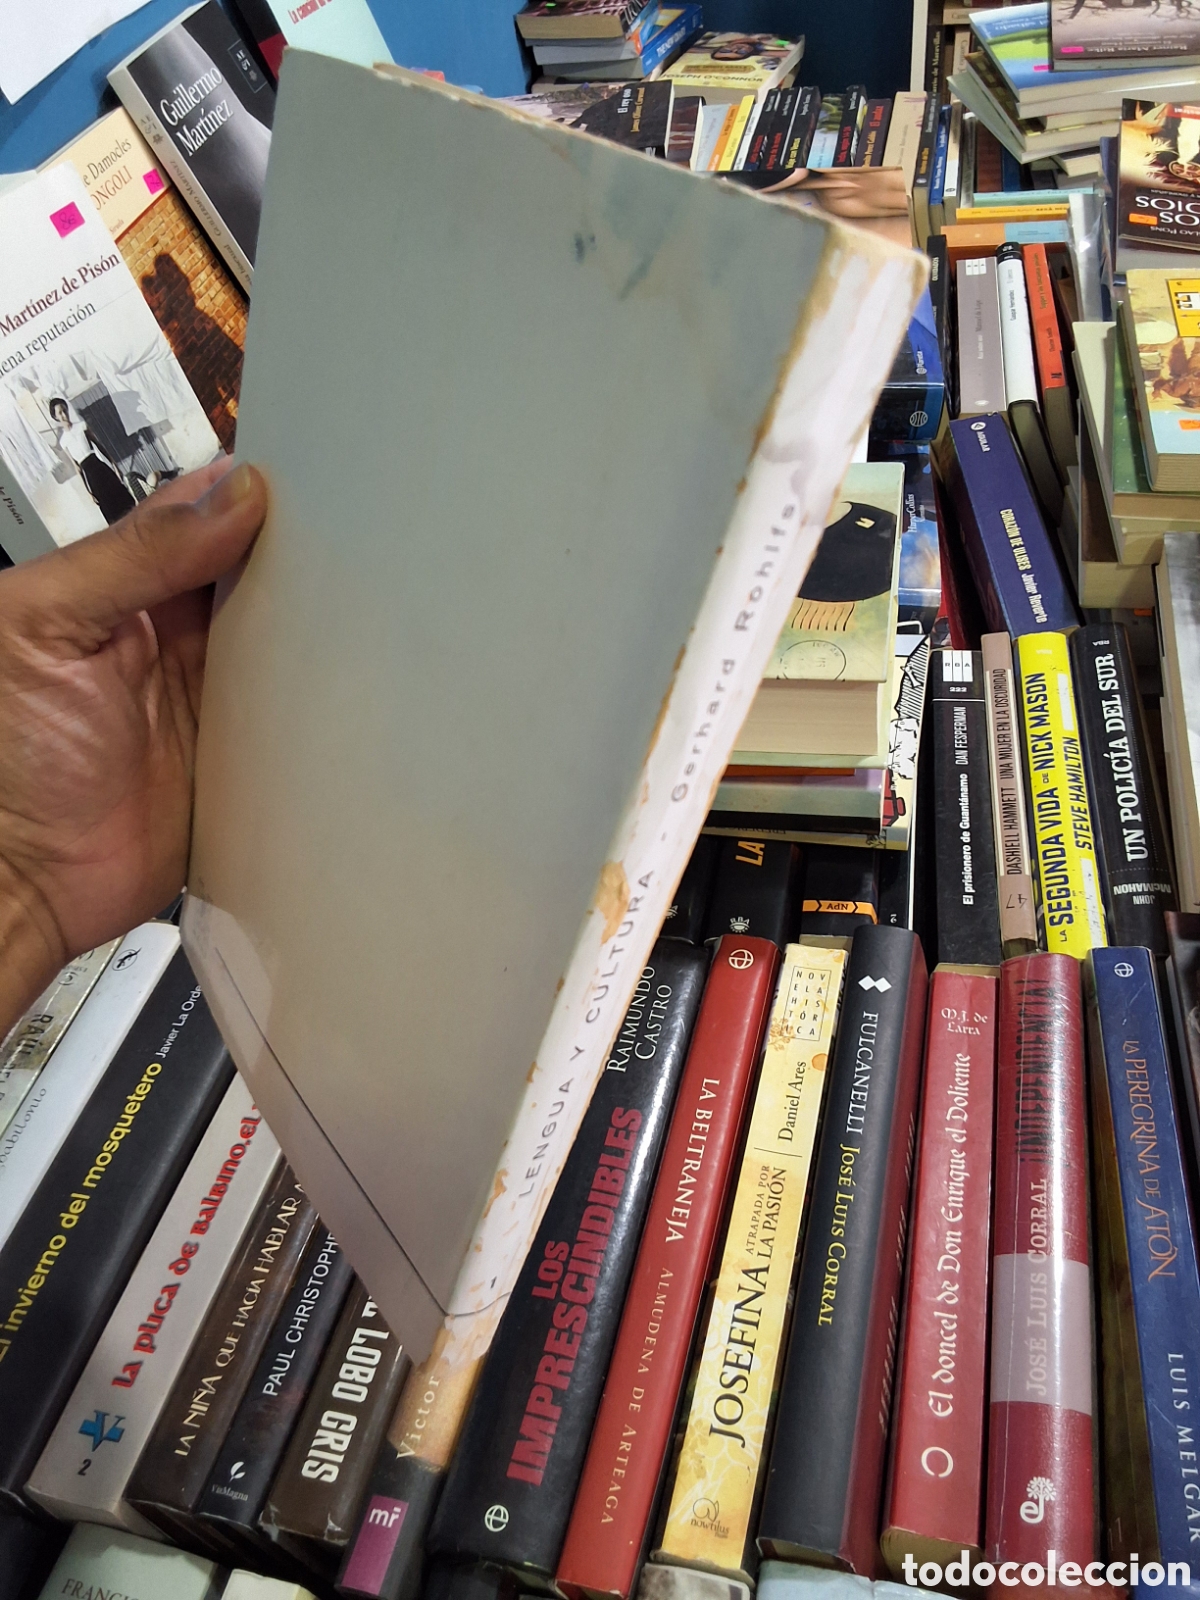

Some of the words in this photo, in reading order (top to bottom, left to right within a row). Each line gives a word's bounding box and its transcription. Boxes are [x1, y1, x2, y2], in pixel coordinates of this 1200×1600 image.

[160, 67, 223, 126] Guillermo
[176, 100, 234, 156] Martínez
[88, 138, 132, 179] Damocles
[0, 284, 63, 338] Martínez
[61, 275, 81, 296] de
[76, 252, 122, 278] Pisón
[25, 300, 97, 357] reputación
[976, 431, 990, 452] AGUILAR
[4, 497, 25, 526] Pisón
[907, 493, 915, 533] HarperCollins
[1000, 508, 1019, 536] CORAZÓN
[1010, 536, 1022, 546] DE
[1012, 546, 1032, 571] ULISES
[1022, 573, 1036, 594] Javier
[1028, 594, 1048, 624] Reverte
[995, 668, 1010, 708] OSCURIDAD
[1095, 652, 1119, 692] SUR
[998, 710, 1010, 721] LA
[1025, 672, 1046, 728] MASON
[1101, 694, 1127, 738] DEL
[954, 706, 968, 749] FESPERMAN
[998, 722, 1011, 734] EN
[1000, 734, 1012, 763] MUJER
[955, 750, 968, 766] DAN
[1000, 764, 1013, 780] UNA
[1032, 730, 1055, 772] NICK
[1063, 736, 1087, 804] HAMILTON
[1042, 772, 1049, 784] DE
[1103, 740, 1140, 832] POLICÍA
[954, 773, 970, 830] Guantánamo
[1001, 787, 1018, 832] HAMMETT
[1036, 786, 1062, 832] VIDA
[518, 1077, 576, 1198] LENGUA
[569, 1045, 586, 1062] Y
[585, 869, 654, 1026] CULTURA
[670, 658, 736, 803] Gerhard
[734, 502, 797, 632] Rohlfs
[960, 830, 970, 843] de
[1071, 806, 1092, 850] STEVE
[1119, 832, 1149, 862] UN
[735, 840, 766, 866] LA
[960, 844, 974, 892] prisionero
[1006, 832, 1022, 875] DASHIELL
[962, 893, 974, 906] El
[1042, 832, 1074, 927] SEGUNDA
[1132, 894, 1156, 906] JOHN
[730, 916, 750, 928] RBA
[1059, 929, 1067, 942] LA
[606, 965, 656, 1074] RAIMUNDO
[634, 984, 674, 1061] CASTRO
[946, 1022, 981, 1036] Larra
[974, 1012, 988, 1024] de
[1122, 1040, 1140, 1056] LA
[699, 1077, 720, 1102] LA
[786, 1060, 807, 1090] Ares
[846, 1010, 880, 1135] FULCANELLI
[945, 1053, 972, 1123] Doliente
[777, 1090, 802, 1143] Daniel
[945, 1123, 966, 1144] el
[1124, 1056, 1160, 1176] PEREGRINA
[4, 1233, 68, 1332] invierno
[60, 1192, 90, 1230] del
[82, 1062, 162, 1189] mosquetero
[155, 1028, 180, 1058] Javier
[172, 1012, 189, 1027] La
[665, 1108, 714, 1242] BELTRANEJA
[836, 1142, 861, 1189] JOSÉ
[940, 1146, 971, 1223] Enrique
[1142, 1178, 1160, 1198] DE
[745, 1191, 766, 1255] ATRAPADA
[758, 1164, 770, 1189] POR
[762, 1166, 788, 1235] PASIÓN
[830, 1190, 854, 1238] LUIS
[1027, 1177, 1049, 1264] CORRAL
[252, 1197, 302, 1276] HABLAR
[756, 1236, 774, 1260] LA
[936, 1229, 963, 1274] Don
[1136, 1197, 1178, 1282] ATÓN
[531, 1240, 570, 1300] LOS
[818, 1242, 848, 1326] CORRAL
[936, 1279, 960, 1306] de
[232, 1276, 267, 1327] HACÍA
[506, 1107, 642, 1487] IMPRESCINDIBLES
[1027, 1271, 1048, 1330] LUIS
[638, 1266, 674, 1374] ALMUDENA
[215, 1330, 242, 1368] QUE
[331, 1325, 390, 1404] LOBO
[708, 1263, 770, 1449] JOSEFINA
[932, 1311, 958, 1384] doncel
[1026, 1336, 1048, 1397] JOSÉ
[262, 1348, 296, 1397] PAUL
[1168, 1352, 1190, 1411] LUIS
[183, 1374, 223, 1429] NIÑA
[396, 1374, 440, 1460] Victor
[628, 1386, 645, 1414] DE
[928, 1390, 954, 1418] El
[77, 1458, 92, 1476] 2
[174, 1432, 197, 1458] LA
[301, 1410, 358, 1484] GRIS
[601, 1424, 637, 1525] ARTEAGA
[690, 1518, 730, 1536] nowtilus
